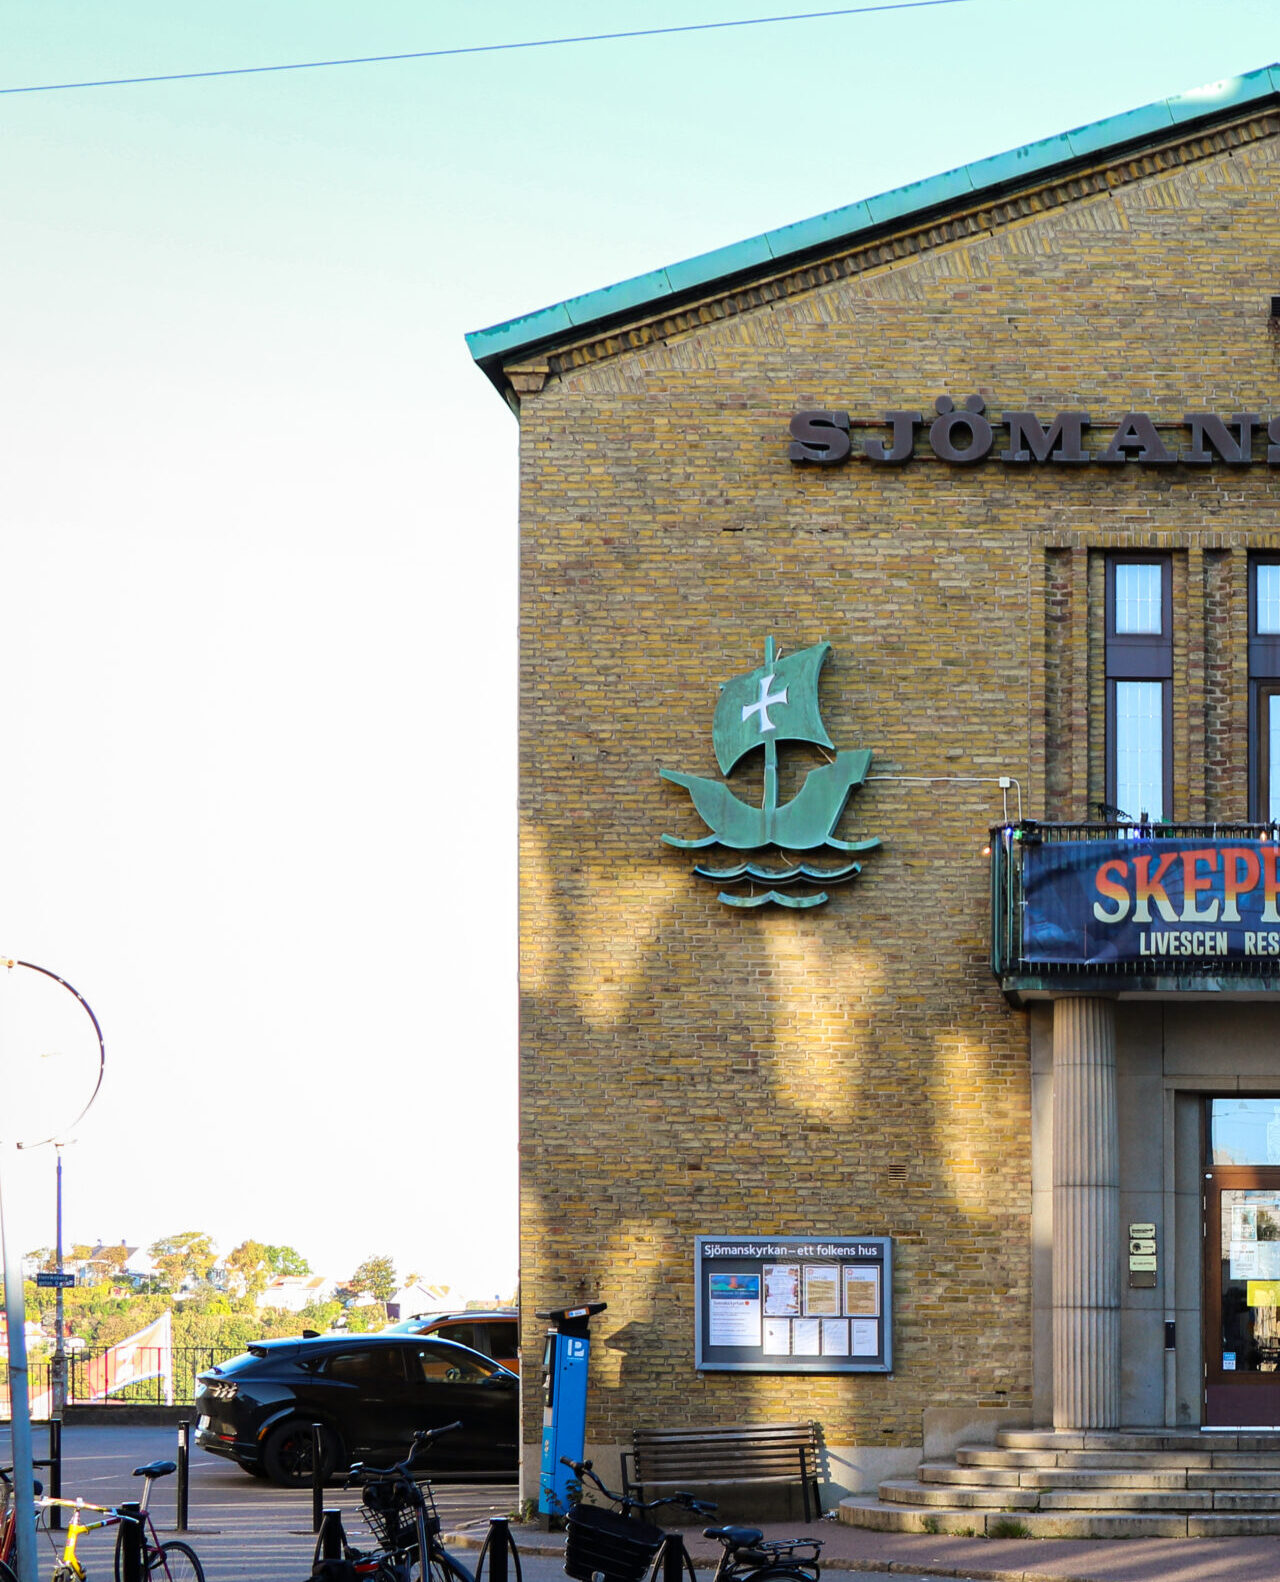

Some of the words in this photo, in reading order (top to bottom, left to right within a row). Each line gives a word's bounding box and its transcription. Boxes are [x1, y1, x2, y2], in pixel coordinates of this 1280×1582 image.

[1139, 930, 1228, 956] LIVESCEN
[704, 1243, 788, 1258] Sjömanskyrkan
[797, 1245, 814, 1256] ett
[816, 1244, 856, 1256] folkens
[858, 1244, 878, 1256] hus
